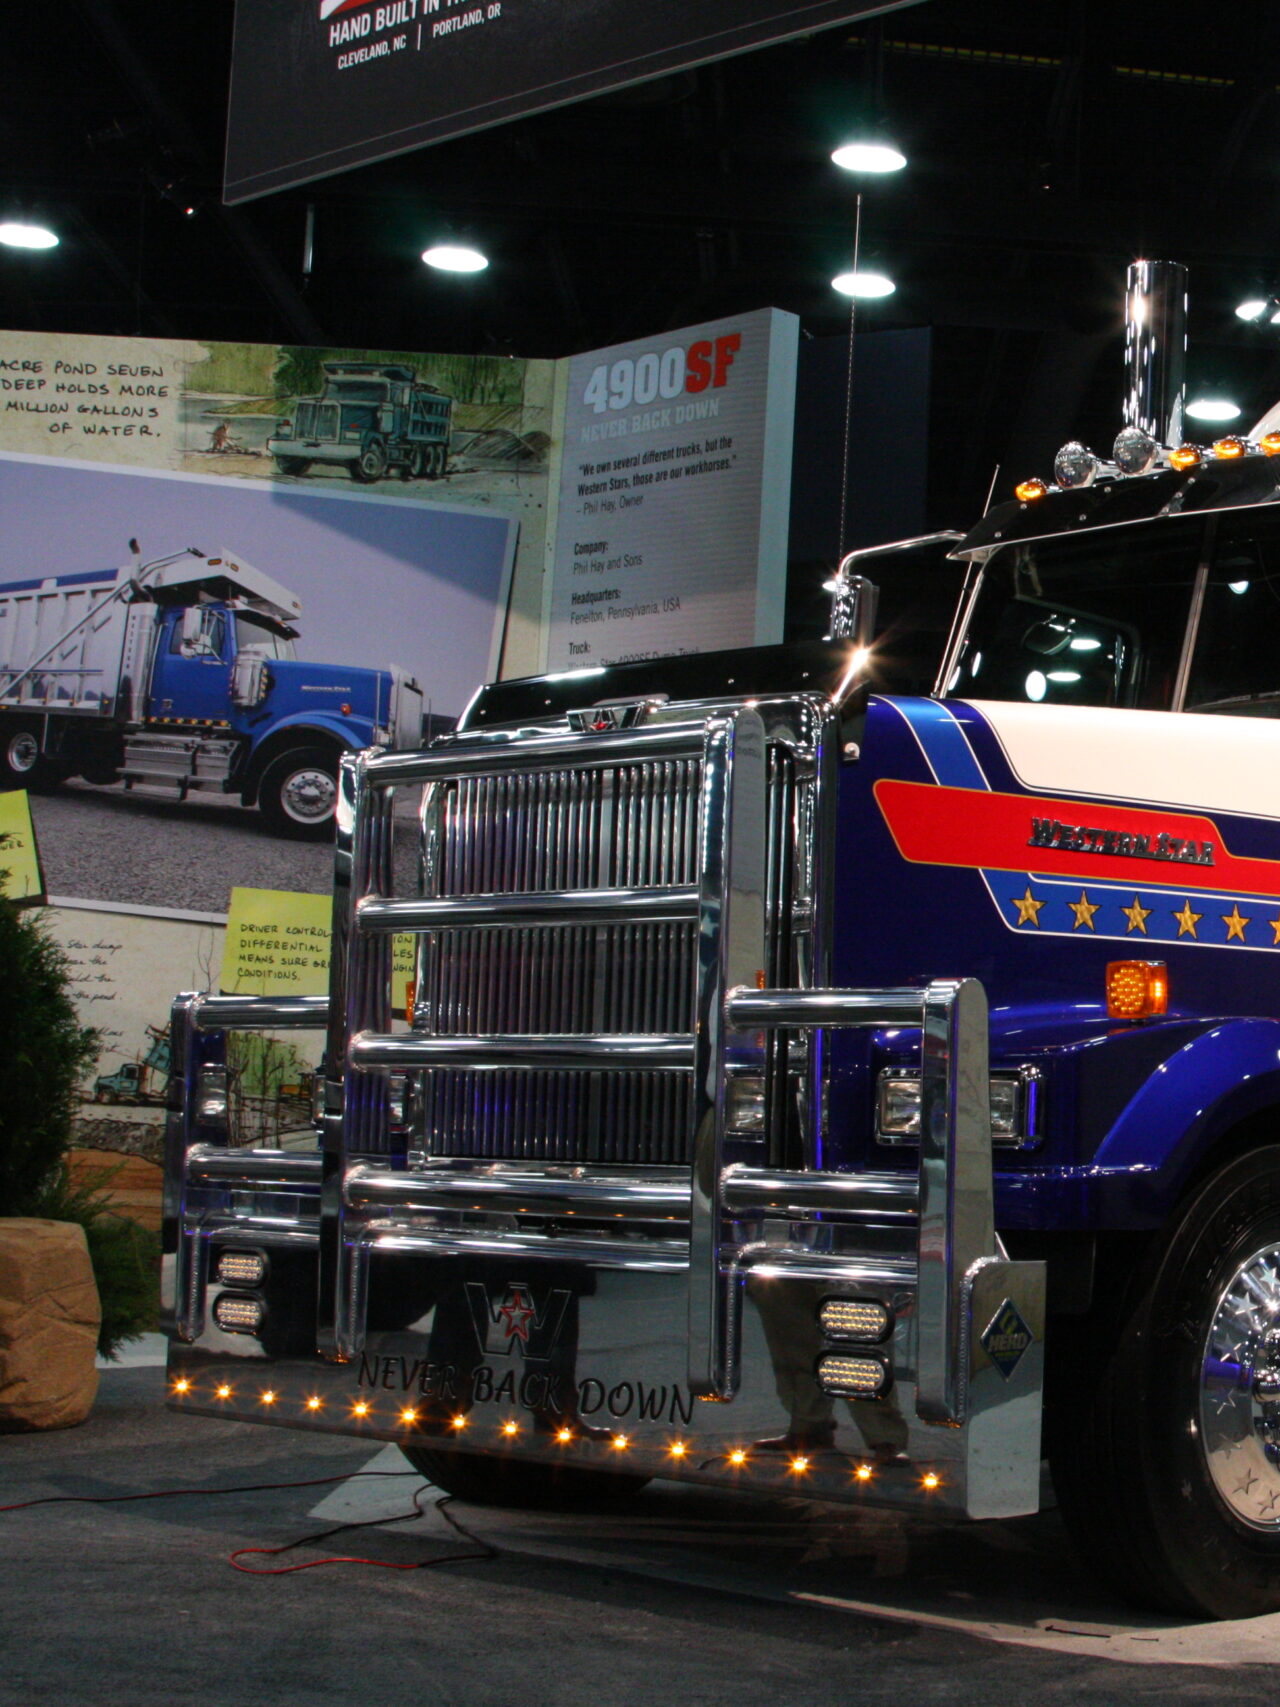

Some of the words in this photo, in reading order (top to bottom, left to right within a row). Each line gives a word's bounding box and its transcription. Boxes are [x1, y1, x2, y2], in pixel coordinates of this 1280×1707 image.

[329, 13, 371, 48] HAND
[375, 0, 417, 31] BUILT
[432, 9, 485, 38] PORTLAND,
[487, 3, 501, 19] OR
[338, 41, 391, 70] CLEVELAND,
[393, 34, 407, 52] NC
[54, 360, 97, 375] POND
[107, 364, 164, 377] SEVEN
[583, 333, 742, 414] 4900SF
[0, 378, 46, 390] DEEP
[56, 383, 110, 395] HOLDS
[119, 385, 169, 397] MORE
[5, 401, 69, 413] MILLION
[77, 404, 159, 418] GALLONS
[48, 422, 73, 433] OF
[83, 424, 161, 437] WATER.
[580, 417, 628, 444] NEVER
[631, 409, 672, 433] BACK
[675, 398, 720, 424] DOWN
[596, 461, 612, 474] own
[613, 454, 641, 471] several
[642, 448, 675, 465] different
[705, 439, 718, 452] but
[719, 436, 733, 450] the
[577, 482, 608, 497] Western
[632, 472, 653, 487] those
[655, 470, 668, 482] are
[670, 466, 683, 479] our
[607, 557, 621, 570] and
[623, 554, 643, 568] Sons
[663, 597, 681, 613] USA
[240, 924, 278, 933] DRIVER
[240, 939, 323, 952] DIFFERENTIAL
[239, 954, 274, 964] MEANS
[281, 957, 308, 966] SURE
[357, 1351, 457, 1400] NEVER
[472, 1366, 562, 1415] BACK
[578, 1378, 695, 1426] DOWN
